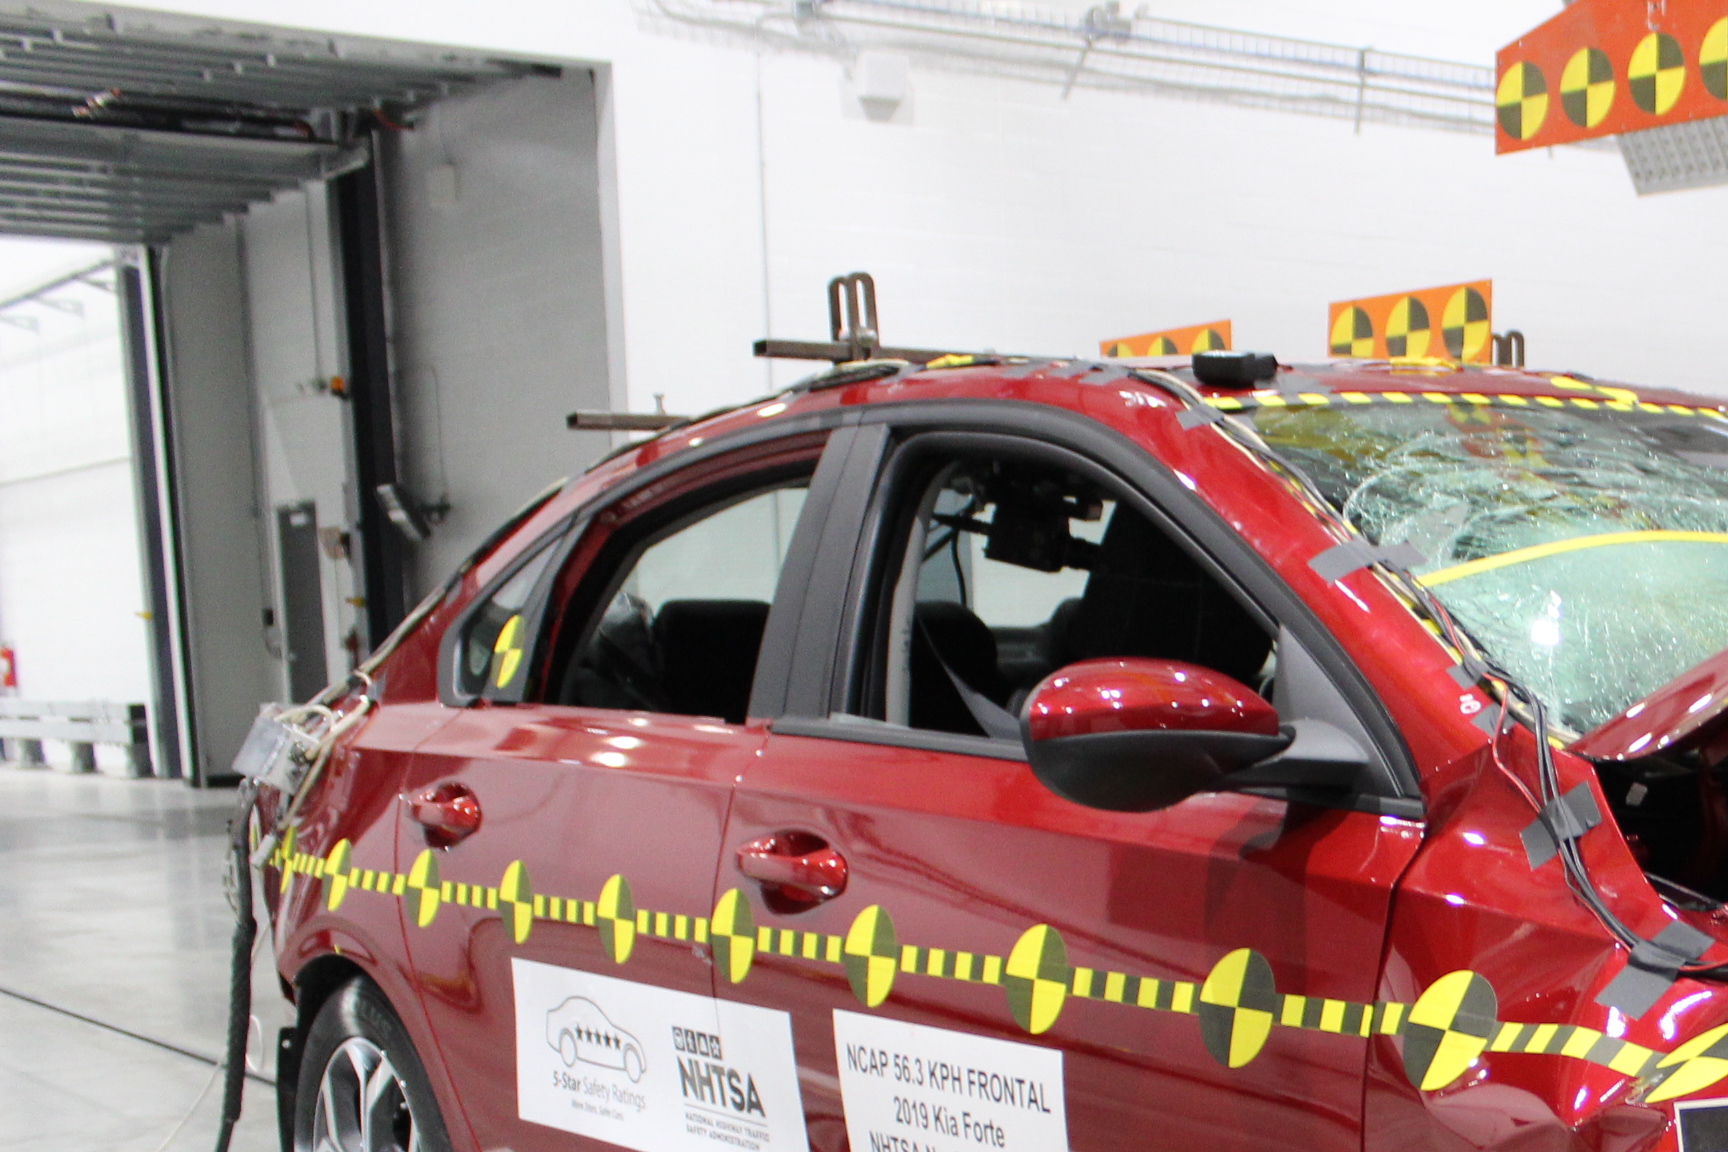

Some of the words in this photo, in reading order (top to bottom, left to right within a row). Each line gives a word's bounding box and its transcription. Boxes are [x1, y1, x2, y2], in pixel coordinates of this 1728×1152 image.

[553, 1070, 581, 1092] 5-Star
[583, 1076, 611, 1103] Safety
[612, 1084, 646, 1113] Ratings
[677, 1055, 766, 1118] NHTSA
[846, 1042, 889, 1078] NCAP
[893, 1053, 924, 1086] 56.3
[927, 1059, 963, 1095] KPH
[967, 1067, 1051, 1114] FRONTAL
[893, 1096, 929, 1129] 2019
[932, 1103, 959, 1137] Kia
[962, 1110, 1005, 1148] Forte
